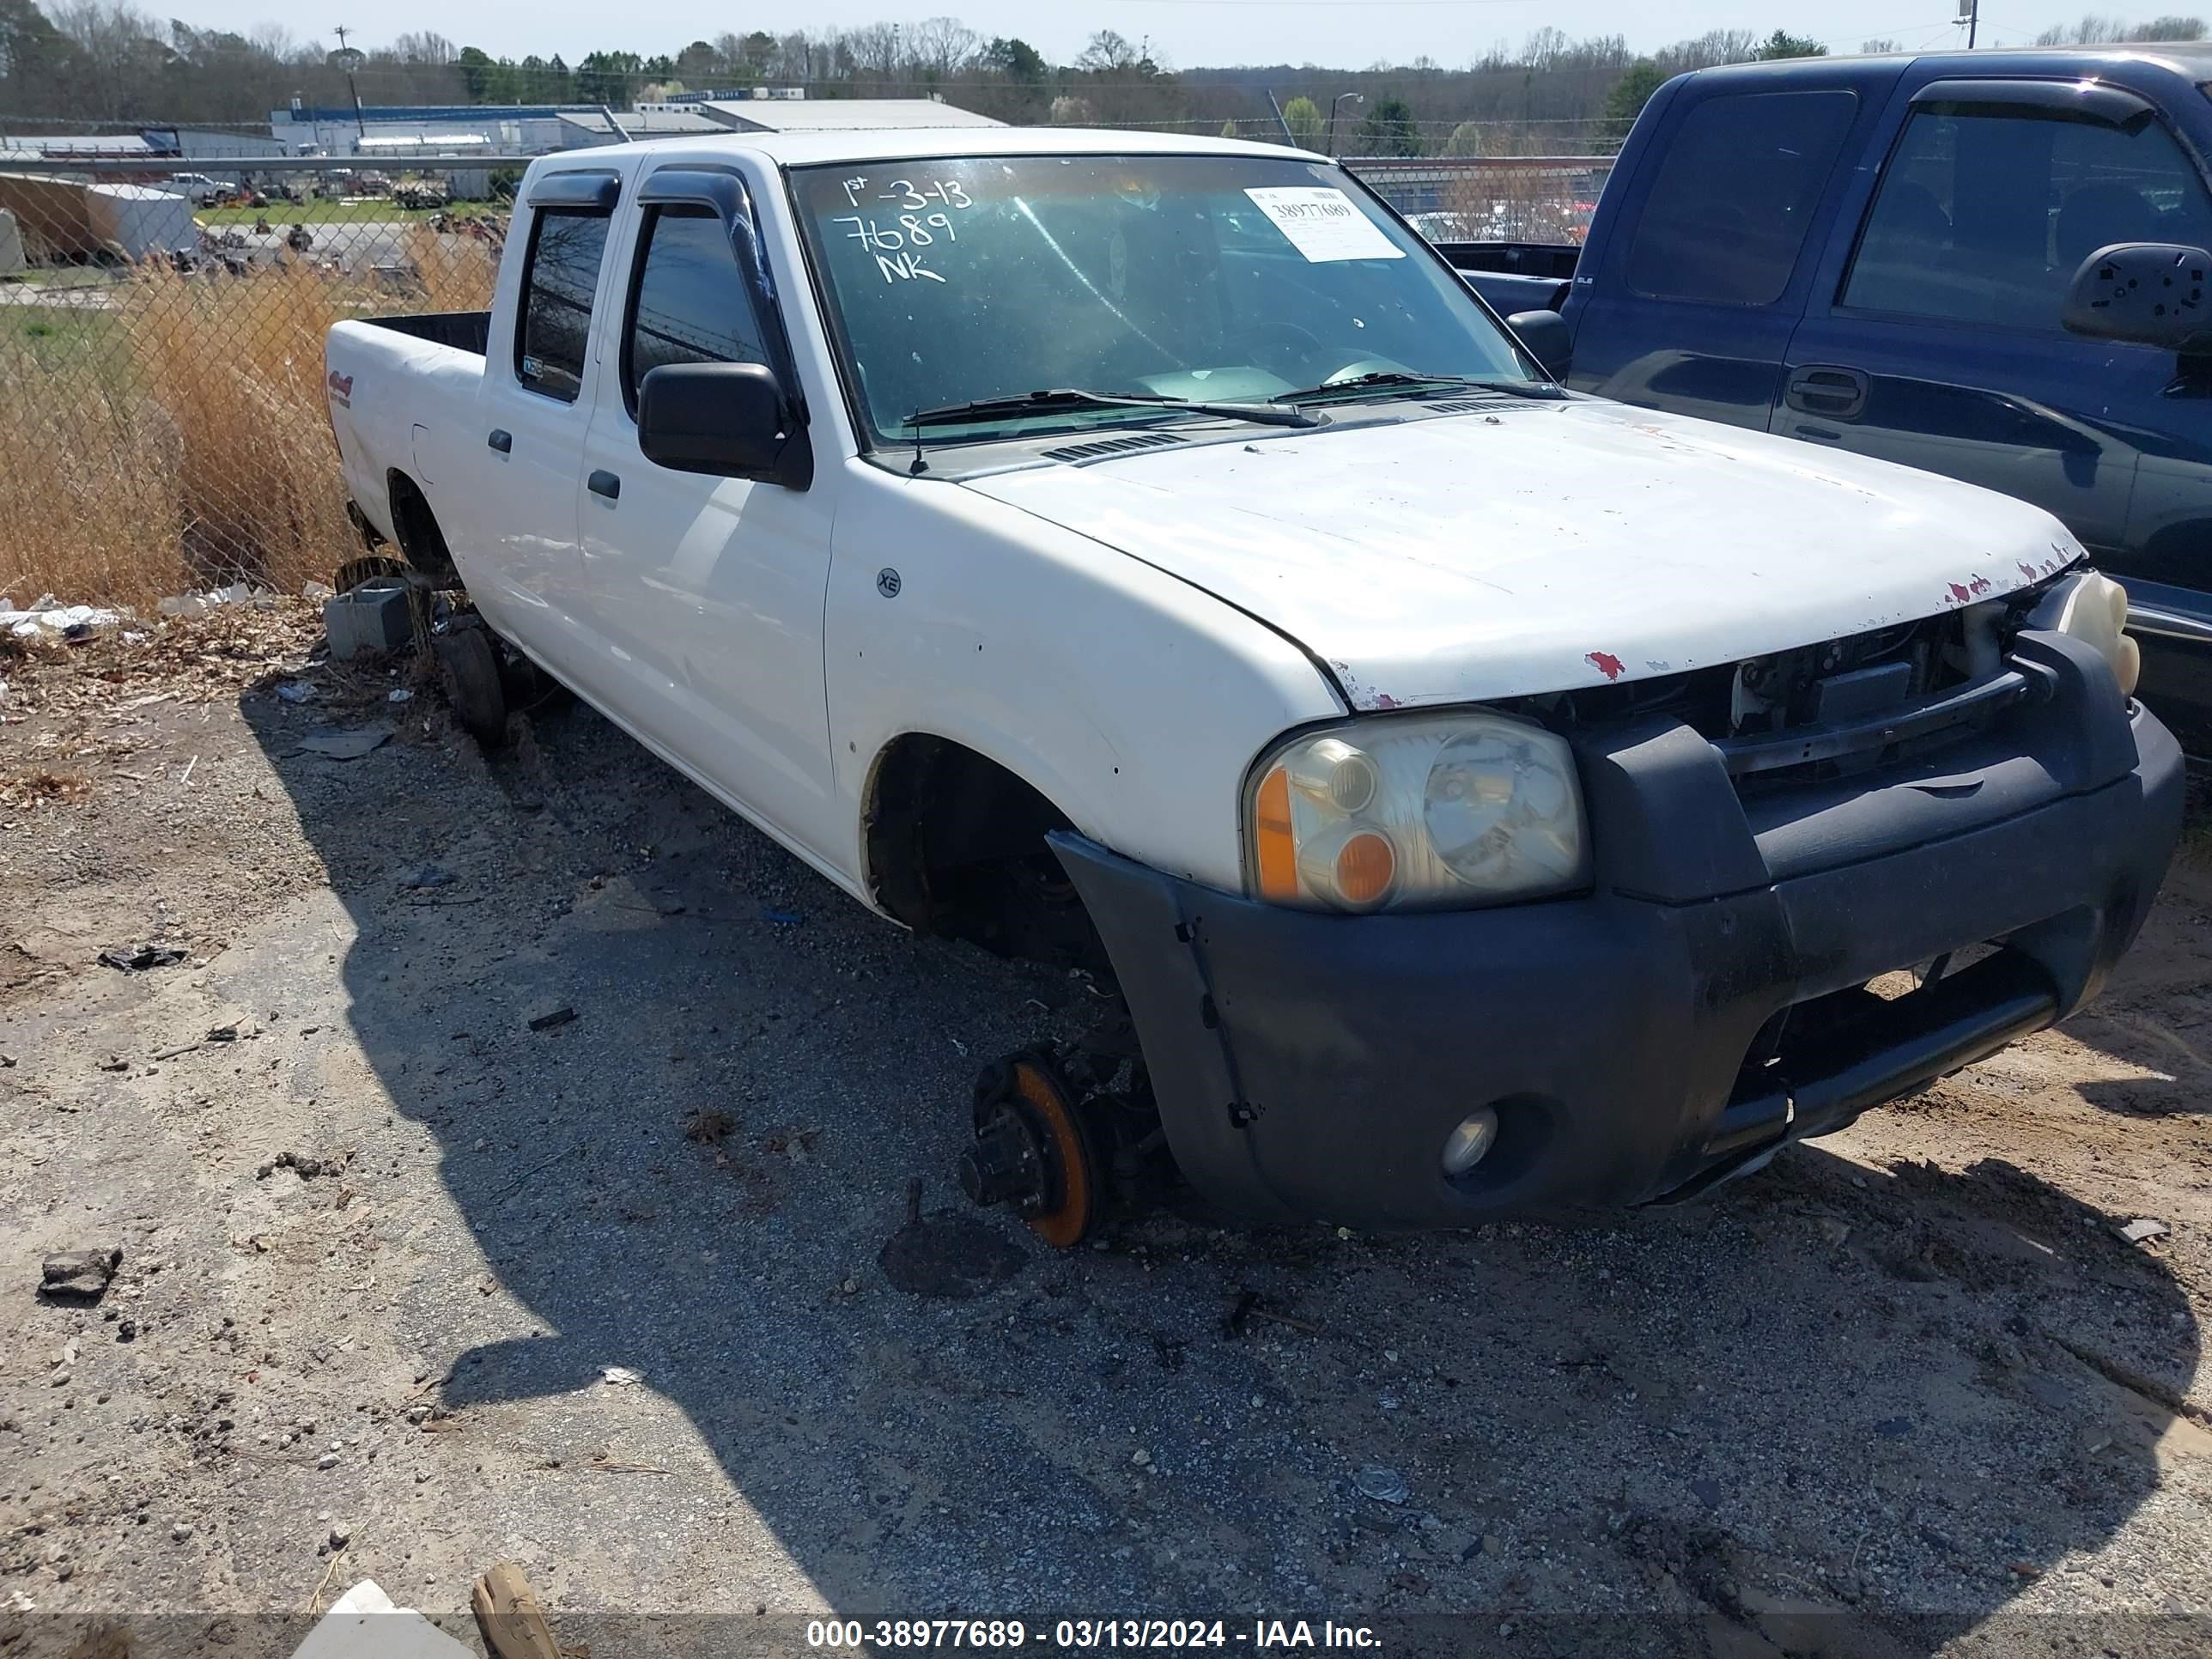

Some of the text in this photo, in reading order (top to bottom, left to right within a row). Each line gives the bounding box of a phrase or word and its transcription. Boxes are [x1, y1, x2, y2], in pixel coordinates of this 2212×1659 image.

[1271, 203, 1352, 219] 38977689
[832, 213, 956, 252] 7689
[874, 252, 946, 283] NK
[878, 573, 898, 592] XE
